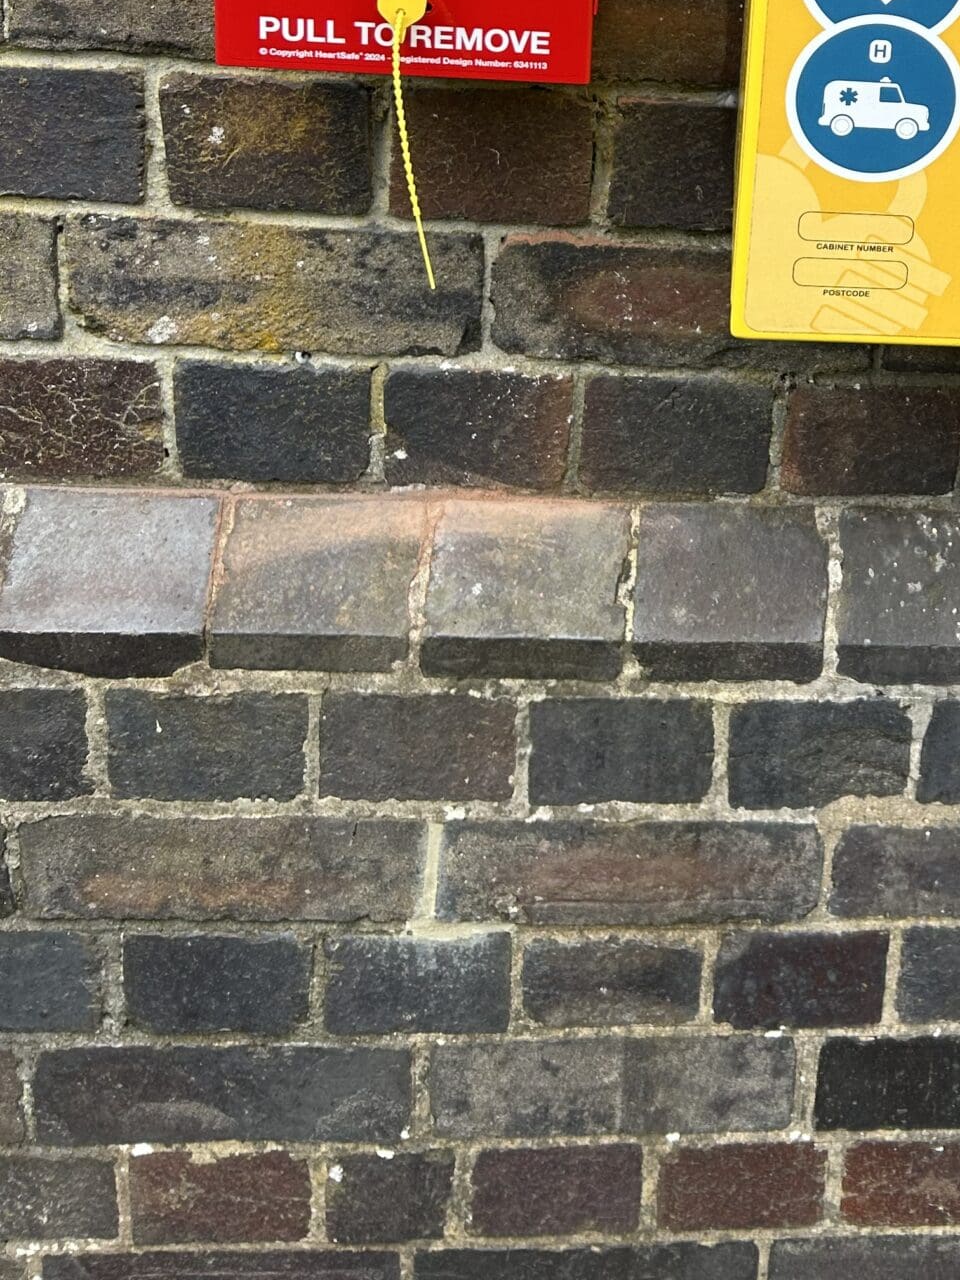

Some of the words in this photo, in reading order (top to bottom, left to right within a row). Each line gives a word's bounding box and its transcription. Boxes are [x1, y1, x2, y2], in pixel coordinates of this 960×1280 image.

[258, 16, 345, 45] PULL
[354, 21, 396, 47] TO
[410, 25, 551, 55] REMOVE
[269, 48, 314, 61] Copyright
[364, 53, 385, 62] 2024
[397, 54, 441, 65] egistered
[442, 56, 473, 67] Design
[474, 58, 513, 68] Number:
[874, 44, 887, 60] H
[816, 242, 854, 253] CABINET
[856, 243, 894, 254] NUMBER
[822, 288, 870, 299] POSTCODE
